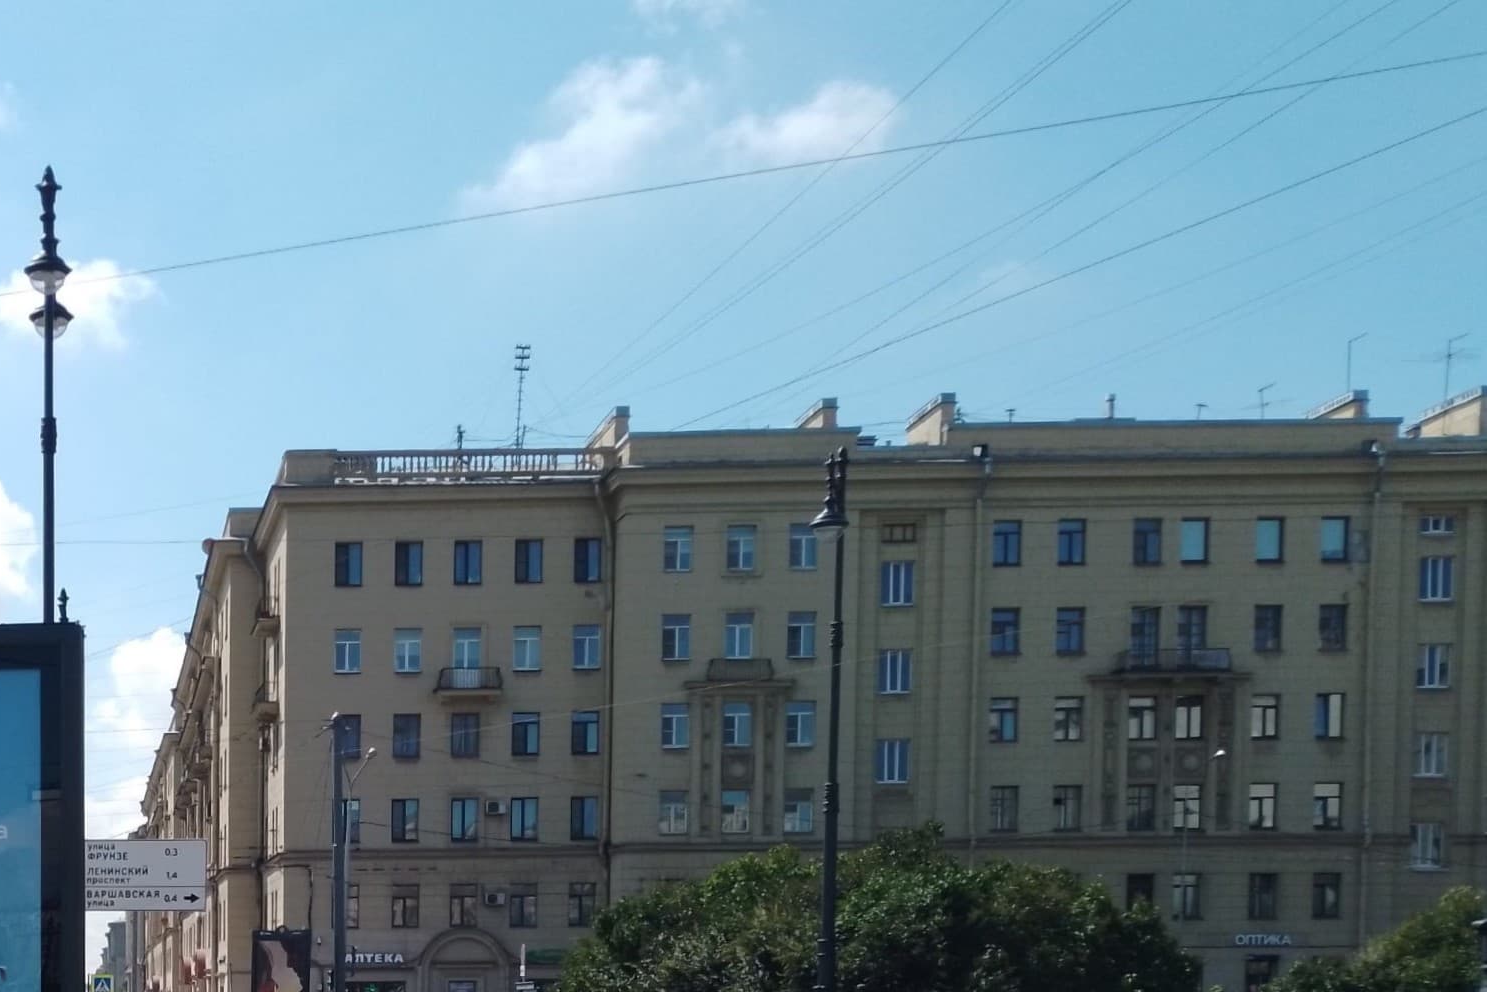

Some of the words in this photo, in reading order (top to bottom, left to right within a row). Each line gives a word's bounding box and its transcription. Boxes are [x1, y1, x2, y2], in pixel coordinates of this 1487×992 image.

[87, 852, 129, 861] ФРУНЗЕ
[87, 865, 149, 876] ЛЕНИНСКИЙ
[87, 890, 161, 899] ВАРШАВСКАЯ
[1235, 934, 1292, 945] ОПТИКА
[344, 953, 404, 964] АПТЕКА
